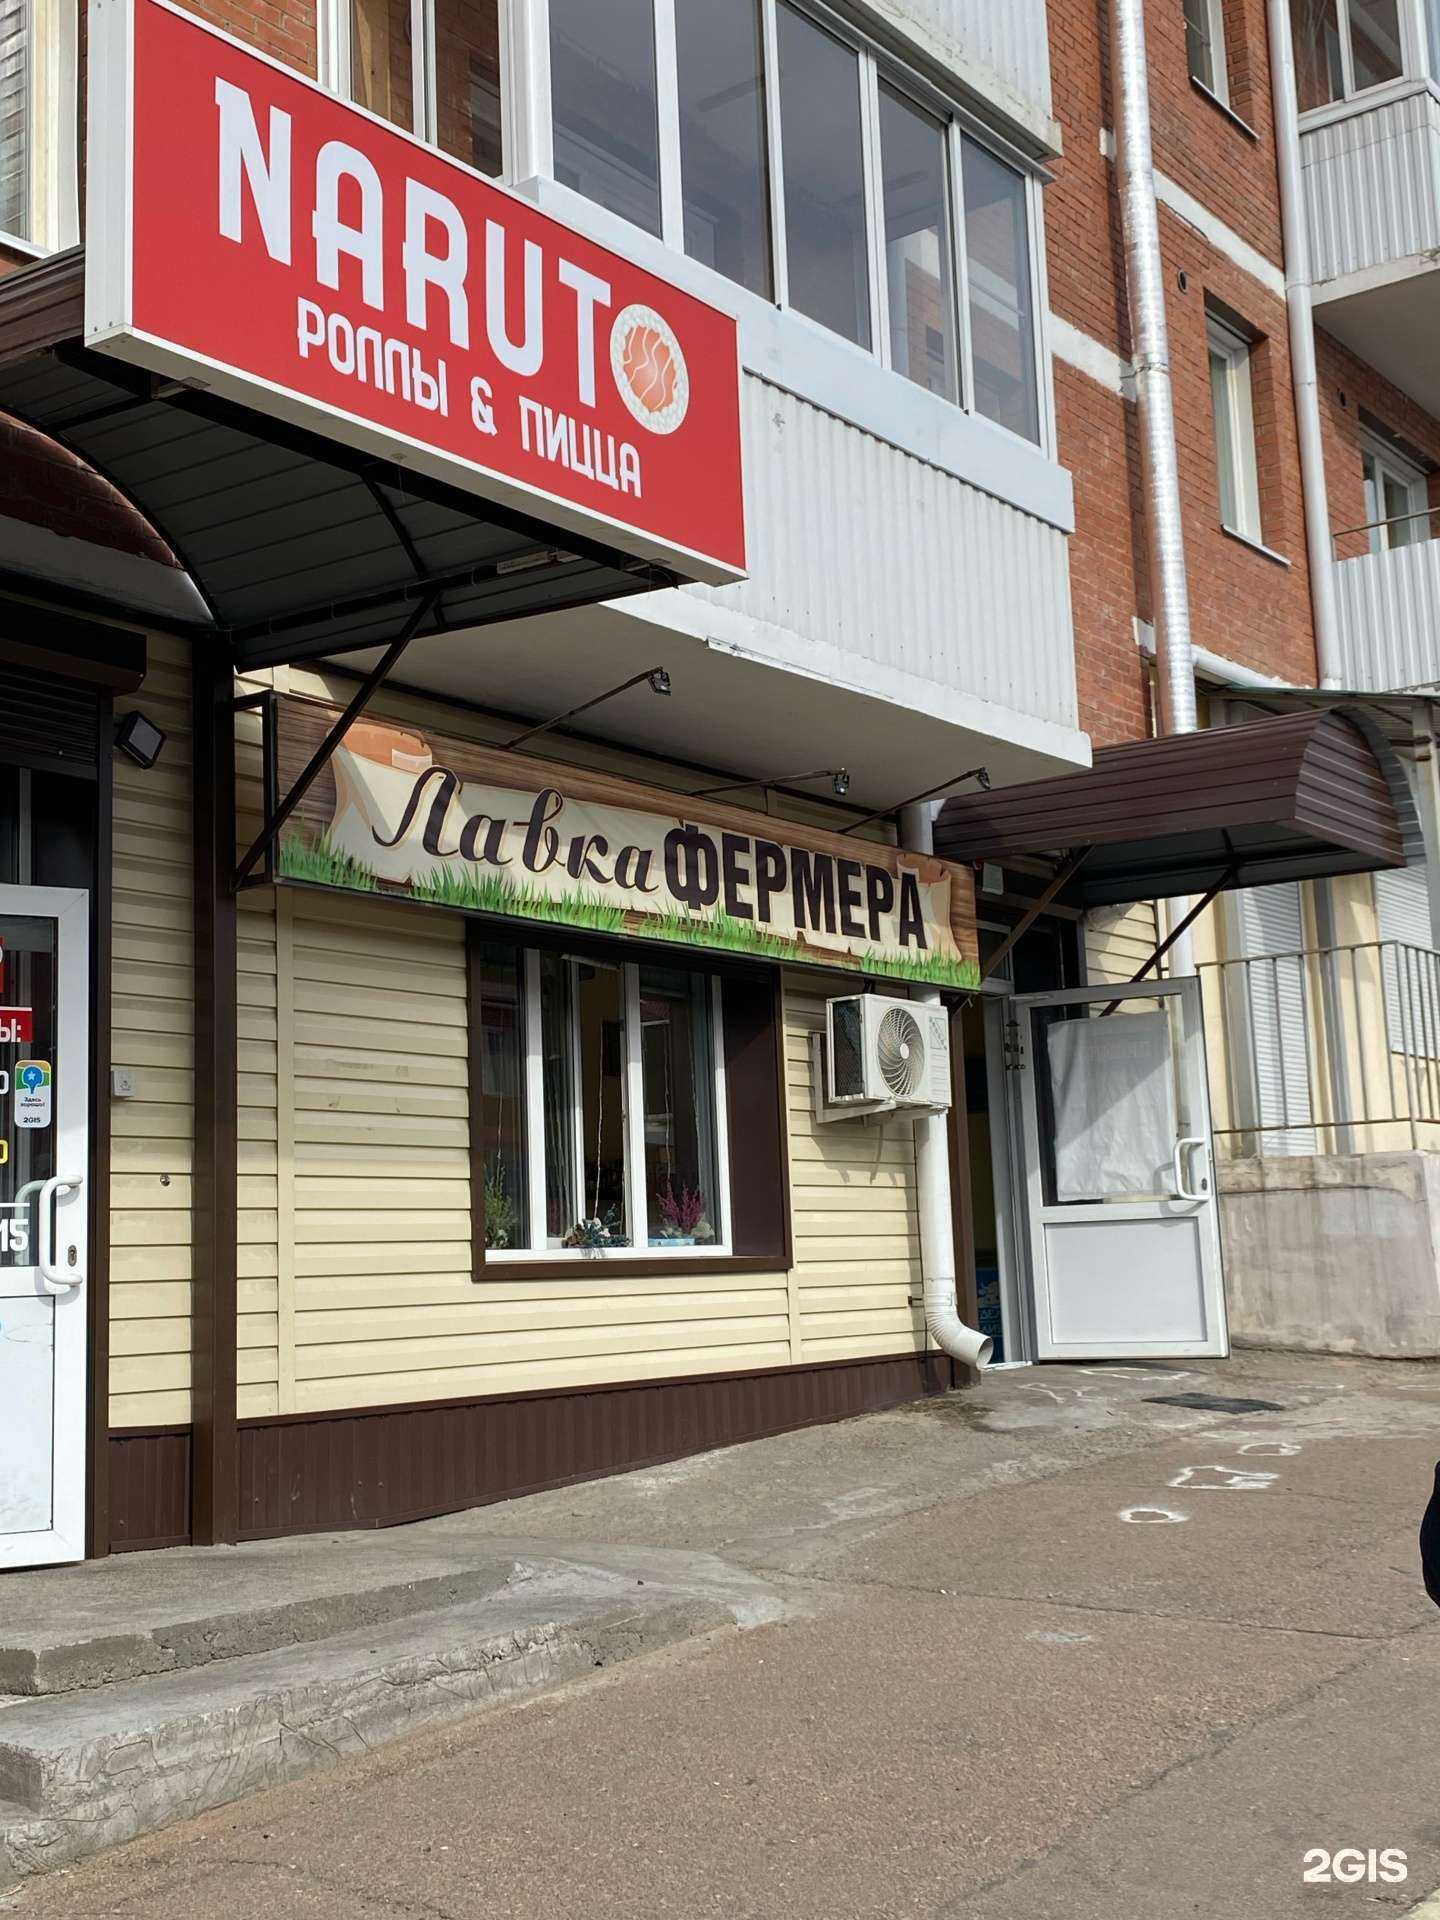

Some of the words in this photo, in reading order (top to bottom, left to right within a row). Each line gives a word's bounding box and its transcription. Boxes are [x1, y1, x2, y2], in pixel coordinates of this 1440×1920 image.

[297, 296, 449, 417] РОЛЛЫ
[470, 376, 498, 436] &
[518, 395, 642, 498] ПИЦЦА
[371, 764, 660, 893] Лавка
[664, 823, 928, 950] ФЕРМЕРА
